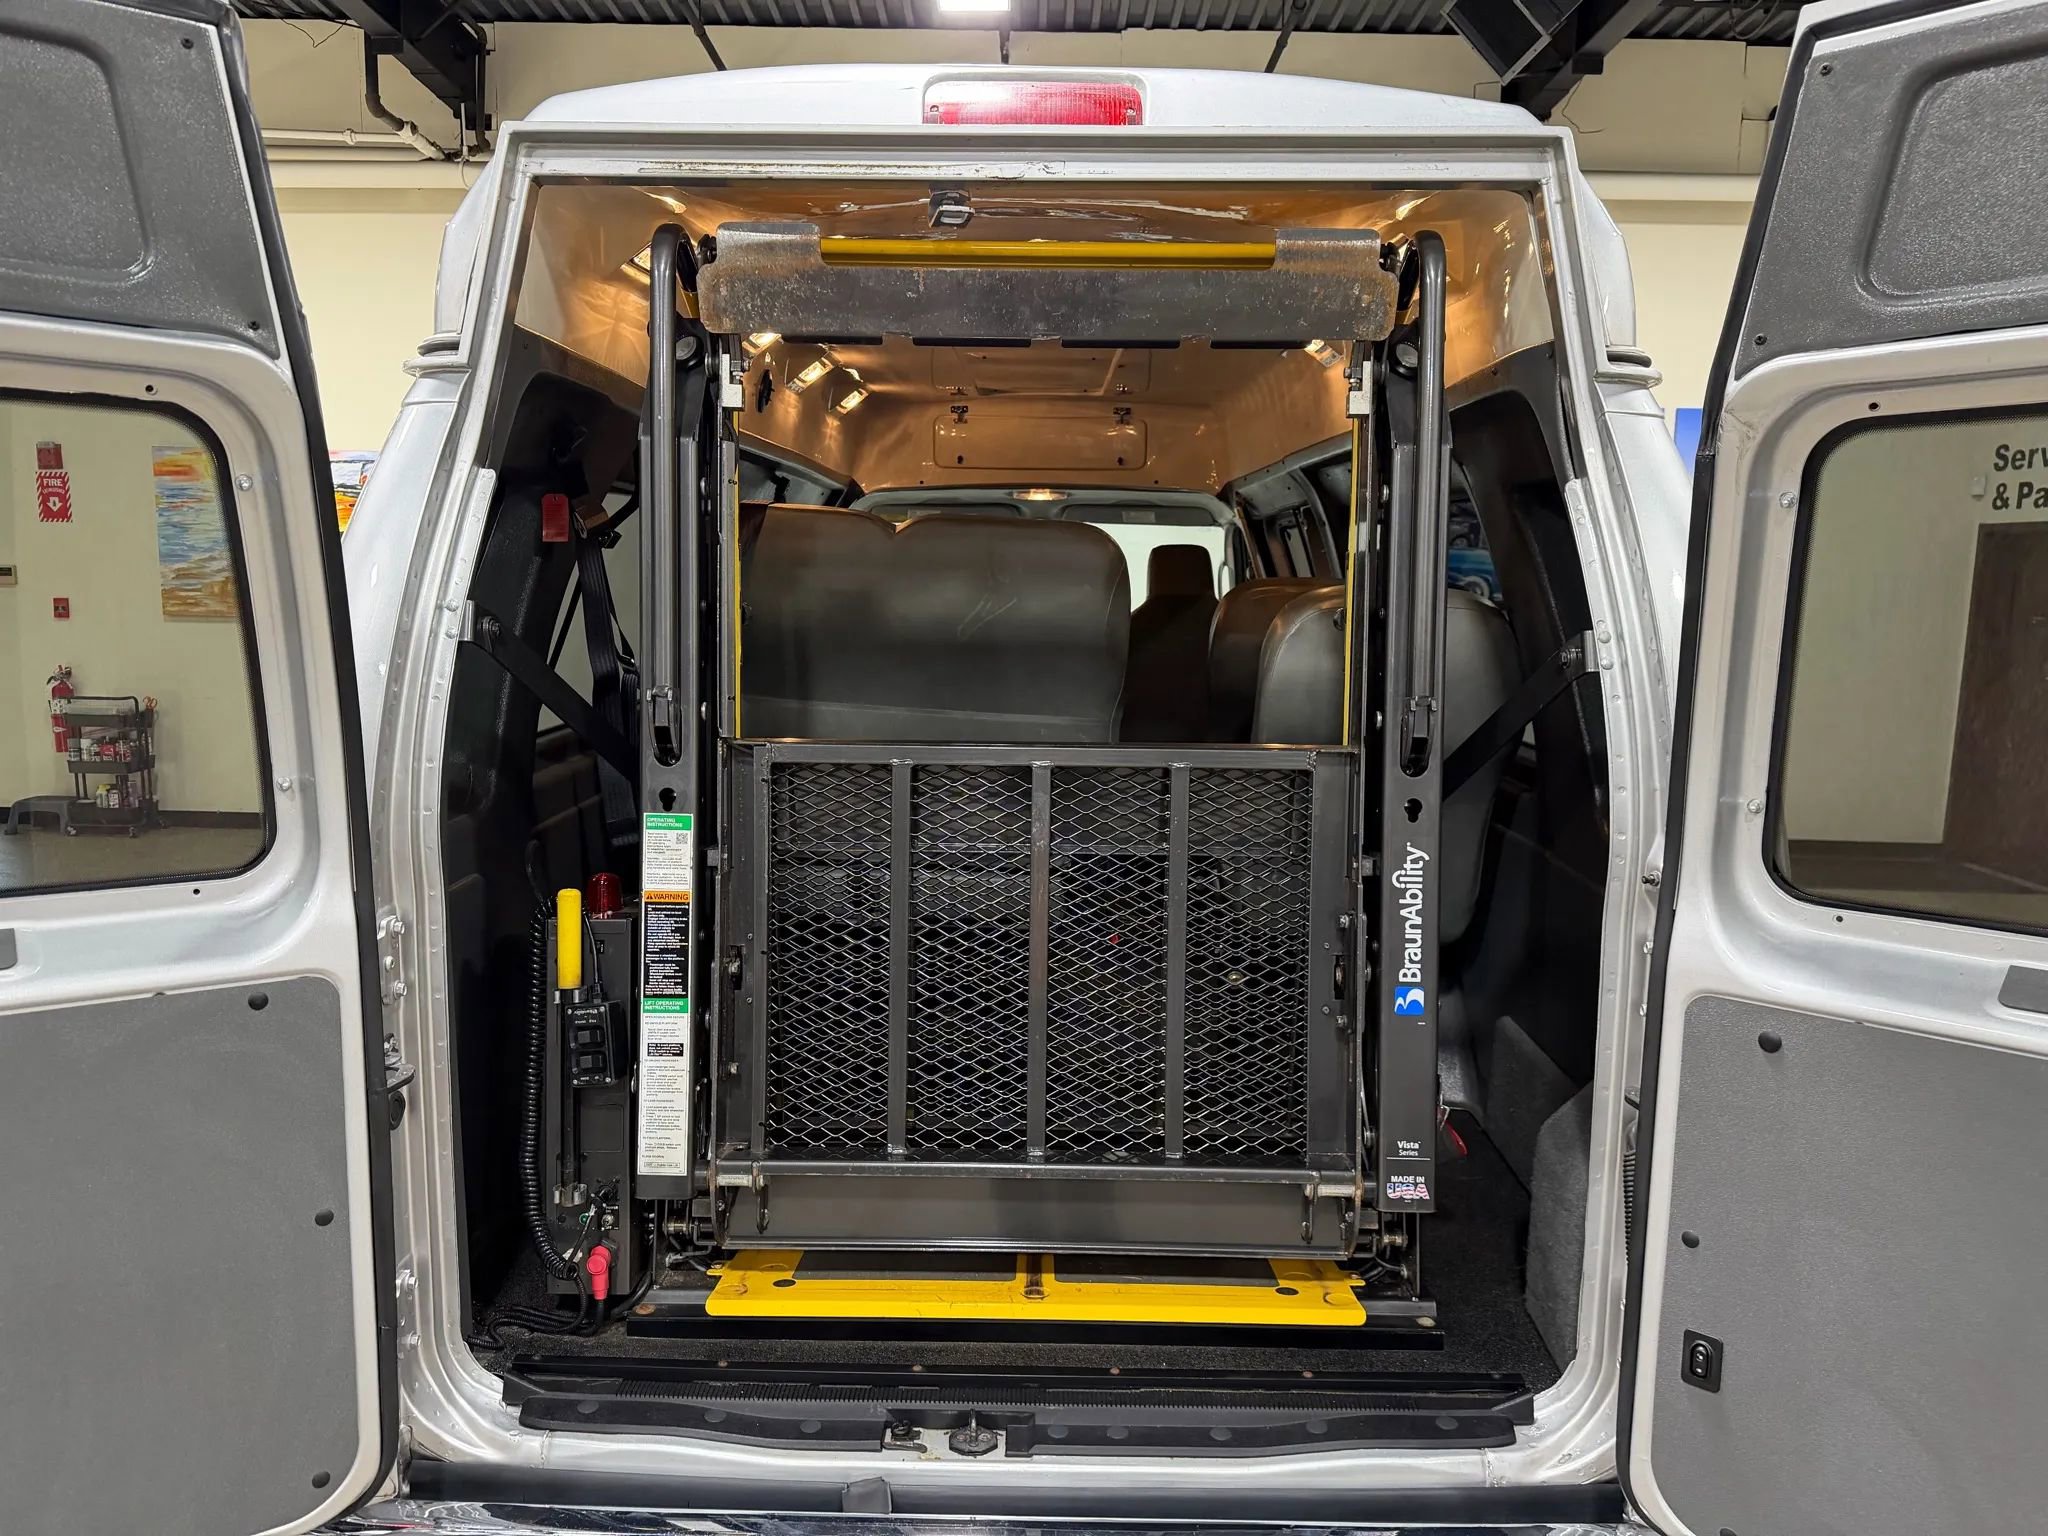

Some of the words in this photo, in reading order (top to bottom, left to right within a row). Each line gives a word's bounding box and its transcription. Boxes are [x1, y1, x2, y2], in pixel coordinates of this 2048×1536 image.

[43, 478, 63, 487] FIRE
[1992, 482, 2009, 511] &
[2016, 481, 2048, 509] Pa
[653, 893, 689, 901] WARNING
[1392, 842, 1430, 983] BraunAbility
[1390, 1175, 1415, 1183] MADE
[1416, 1175, 1425, 1184] IN
[1386, 1182, 1430, 1200] USA
